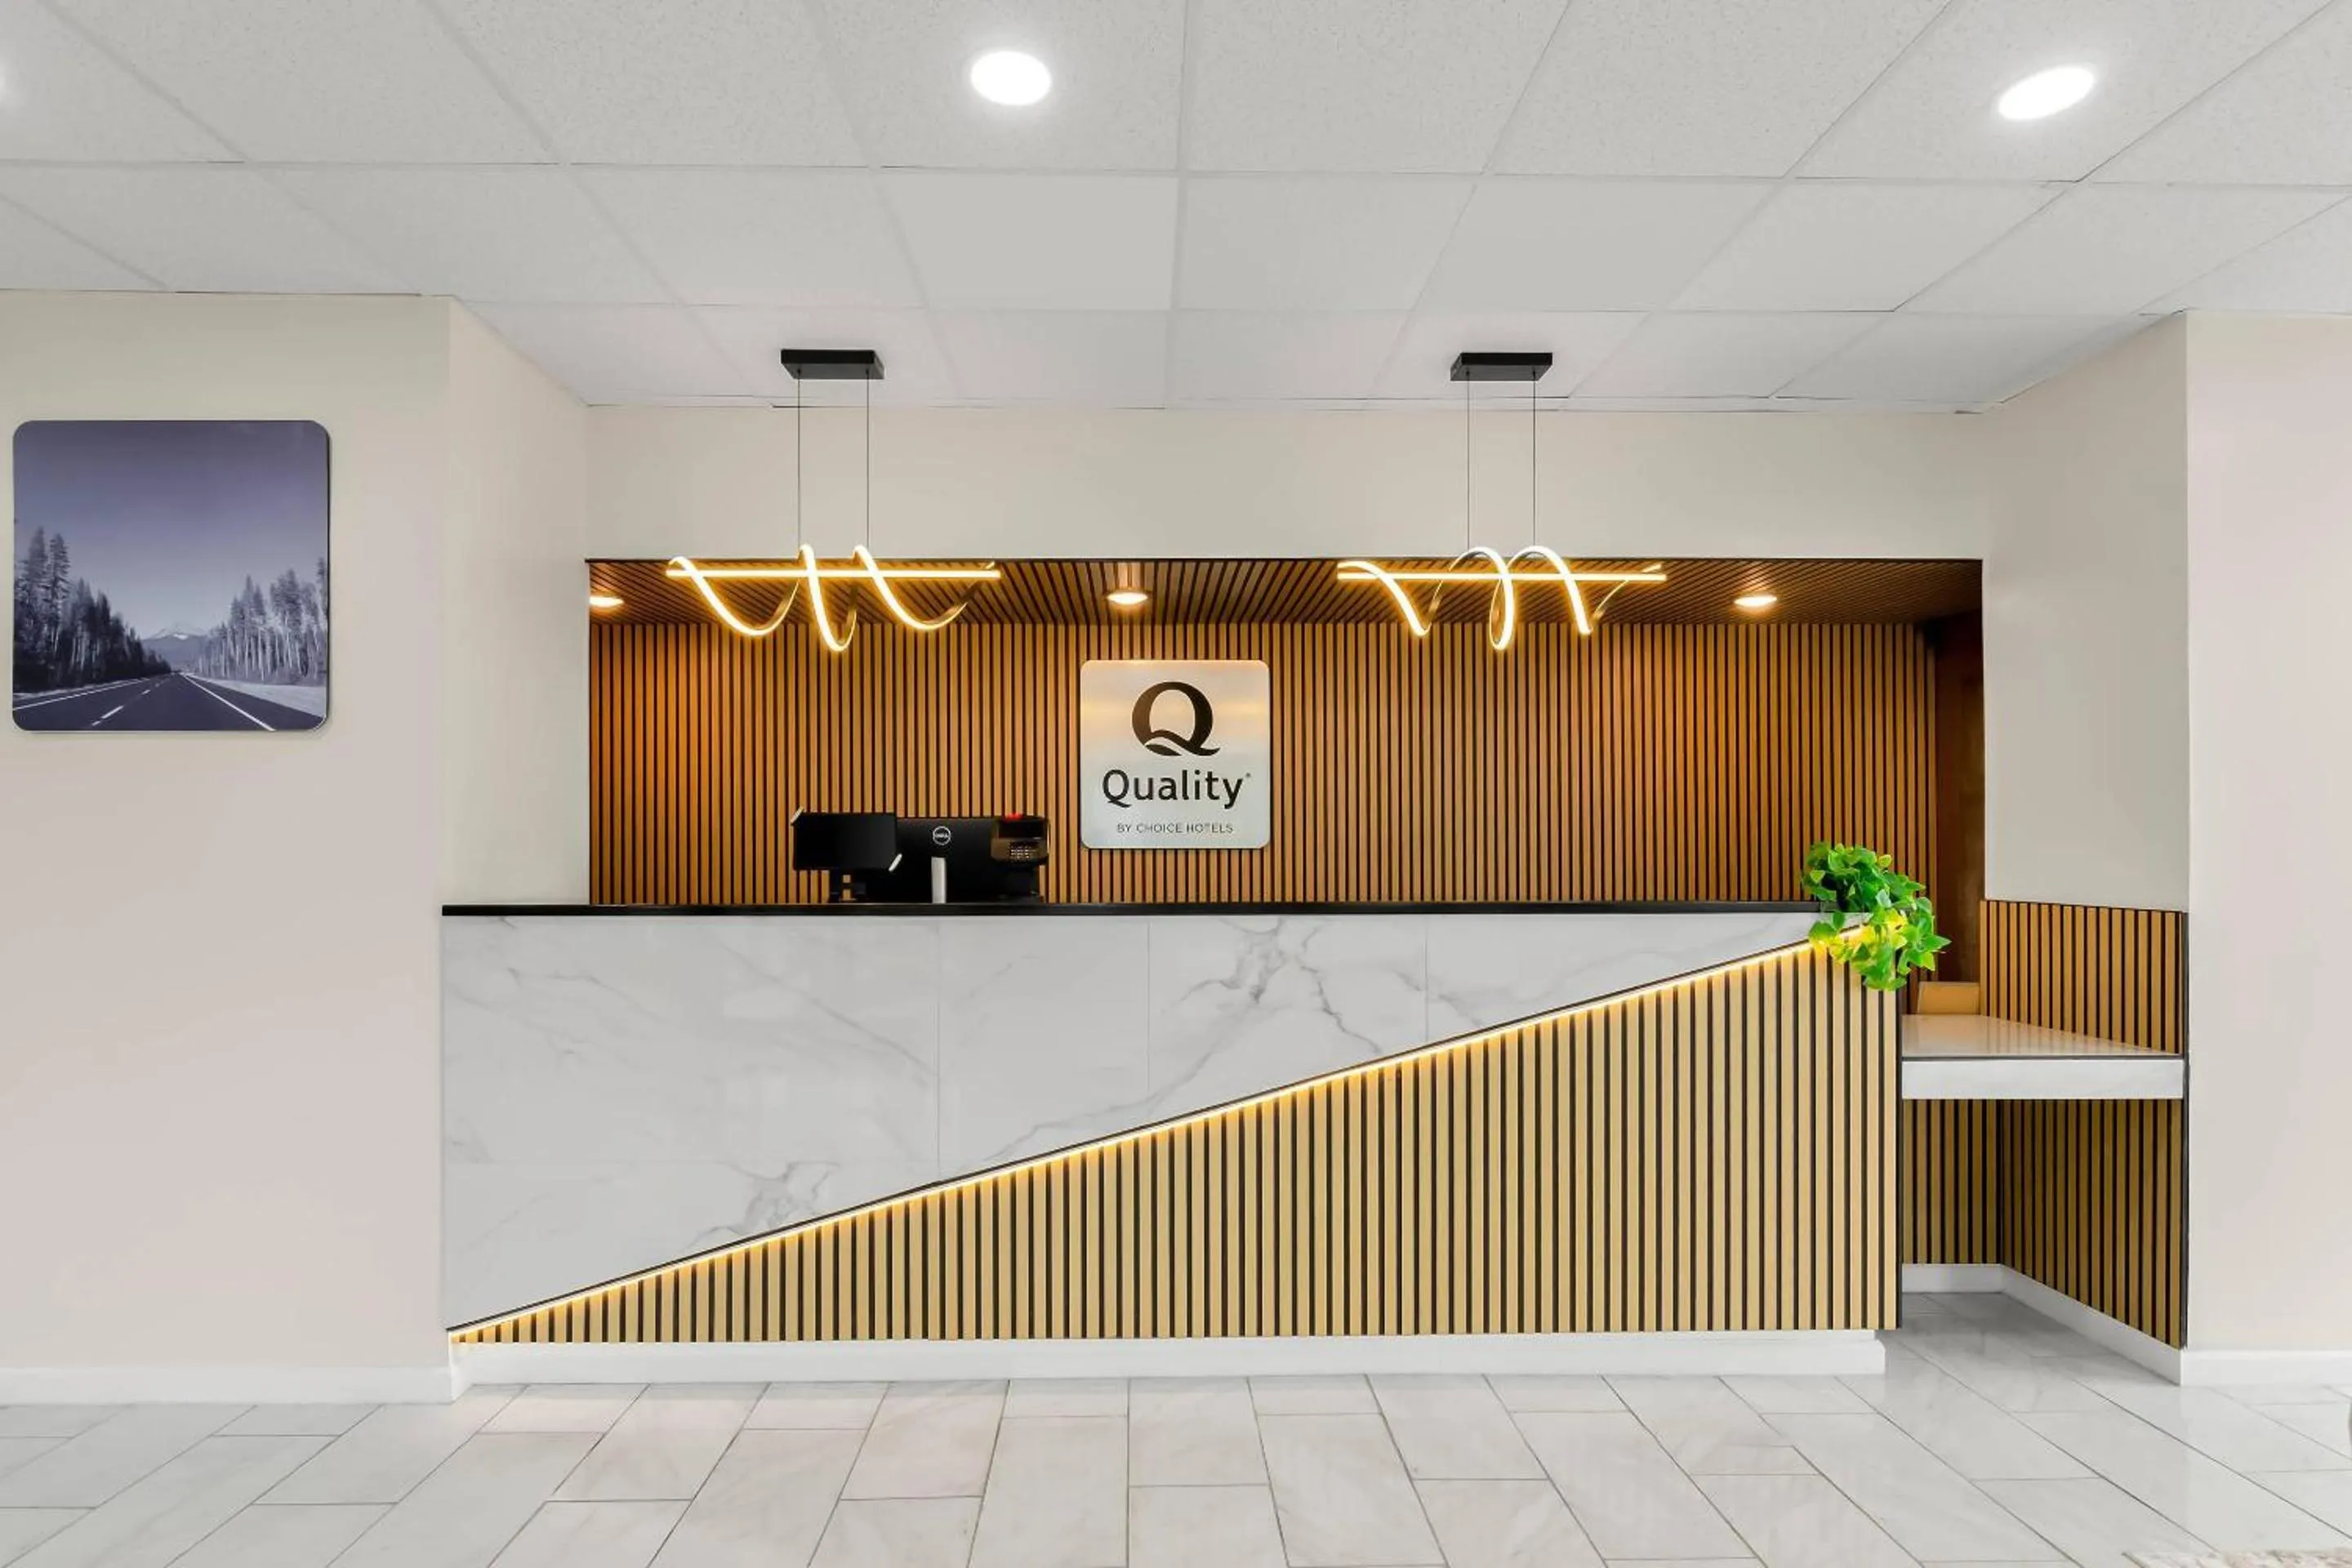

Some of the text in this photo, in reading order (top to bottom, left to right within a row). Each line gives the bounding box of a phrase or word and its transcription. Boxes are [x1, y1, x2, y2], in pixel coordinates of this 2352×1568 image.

[1132, 681, 1220, 756] Q
[1102, 769, 1244, 809] Quality
[1117, 822, 1233, 834] BY CHOICE HOTELS
